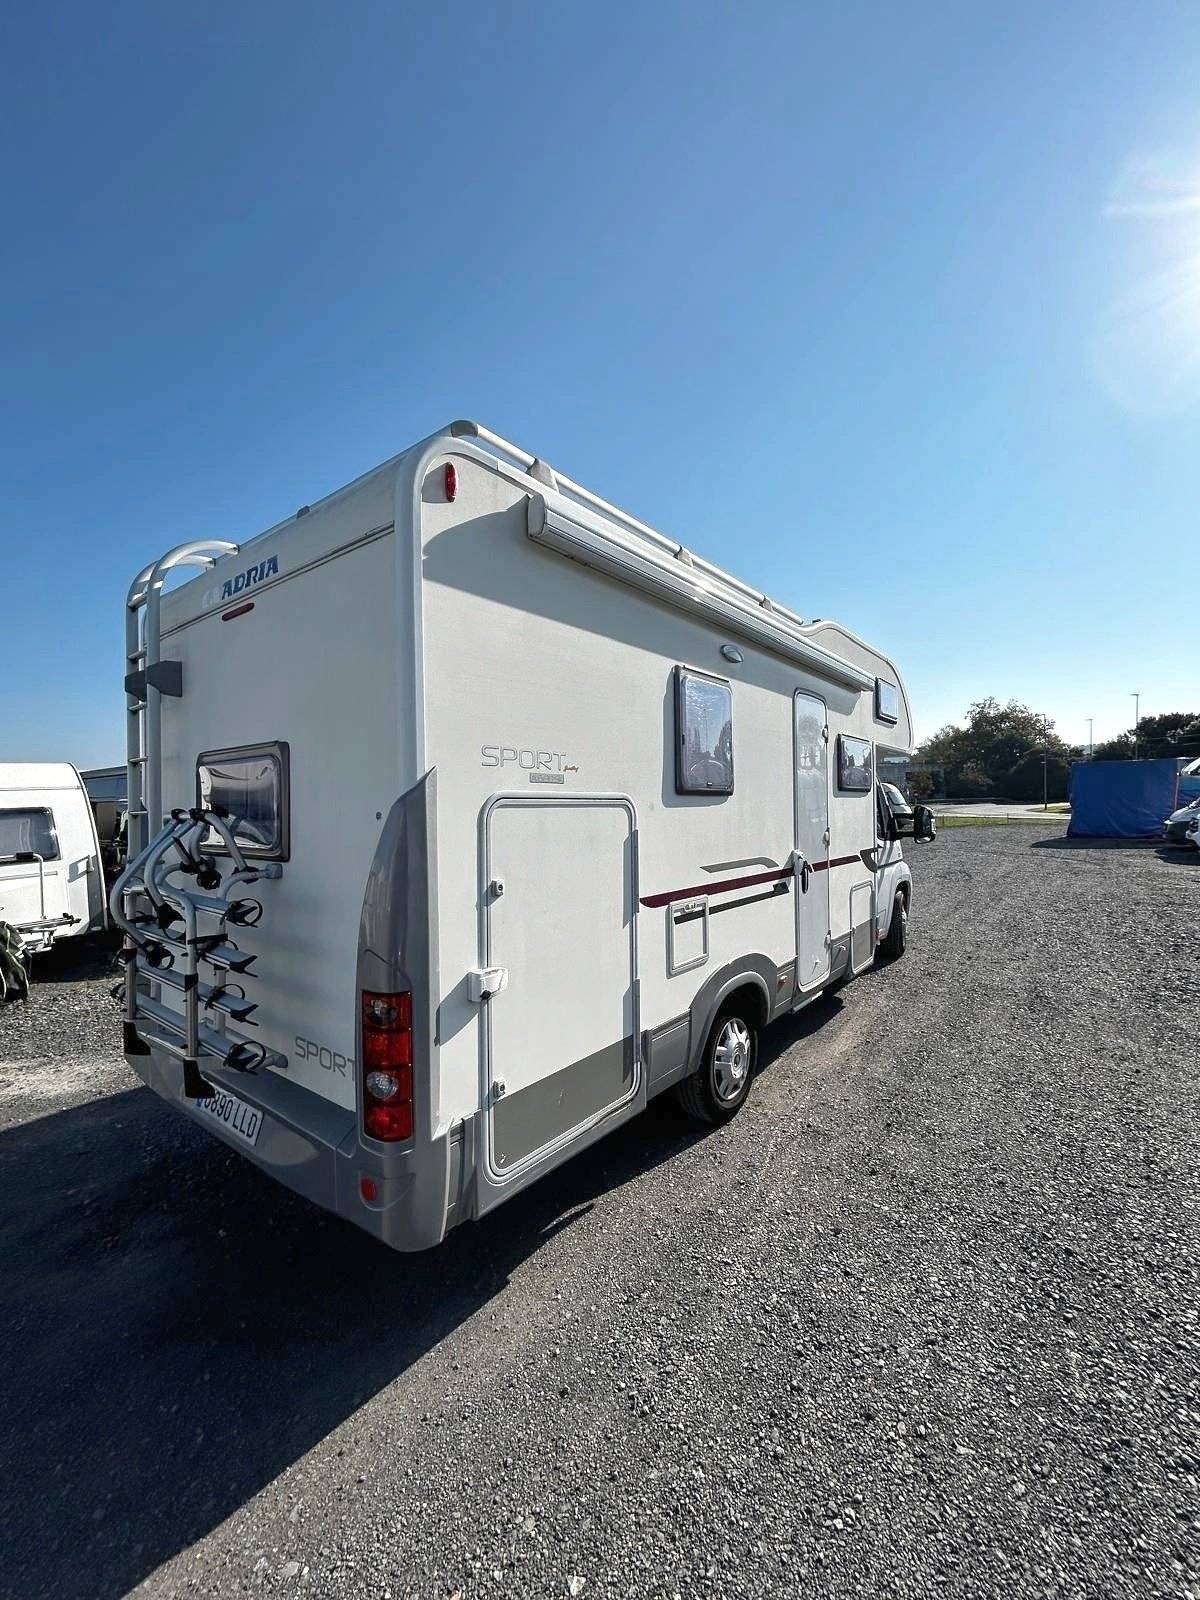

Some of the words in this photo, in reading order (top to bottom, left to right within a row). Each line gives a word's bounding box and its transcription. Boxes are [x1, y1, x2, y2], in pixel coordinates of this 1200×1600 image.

[222, 554, 279, 600] ADRIA
[481, 744, 567, 771] SPORT
[294, 1036, 355, 1081] SPORT
[232, 1103, 258, 1138] LLD
